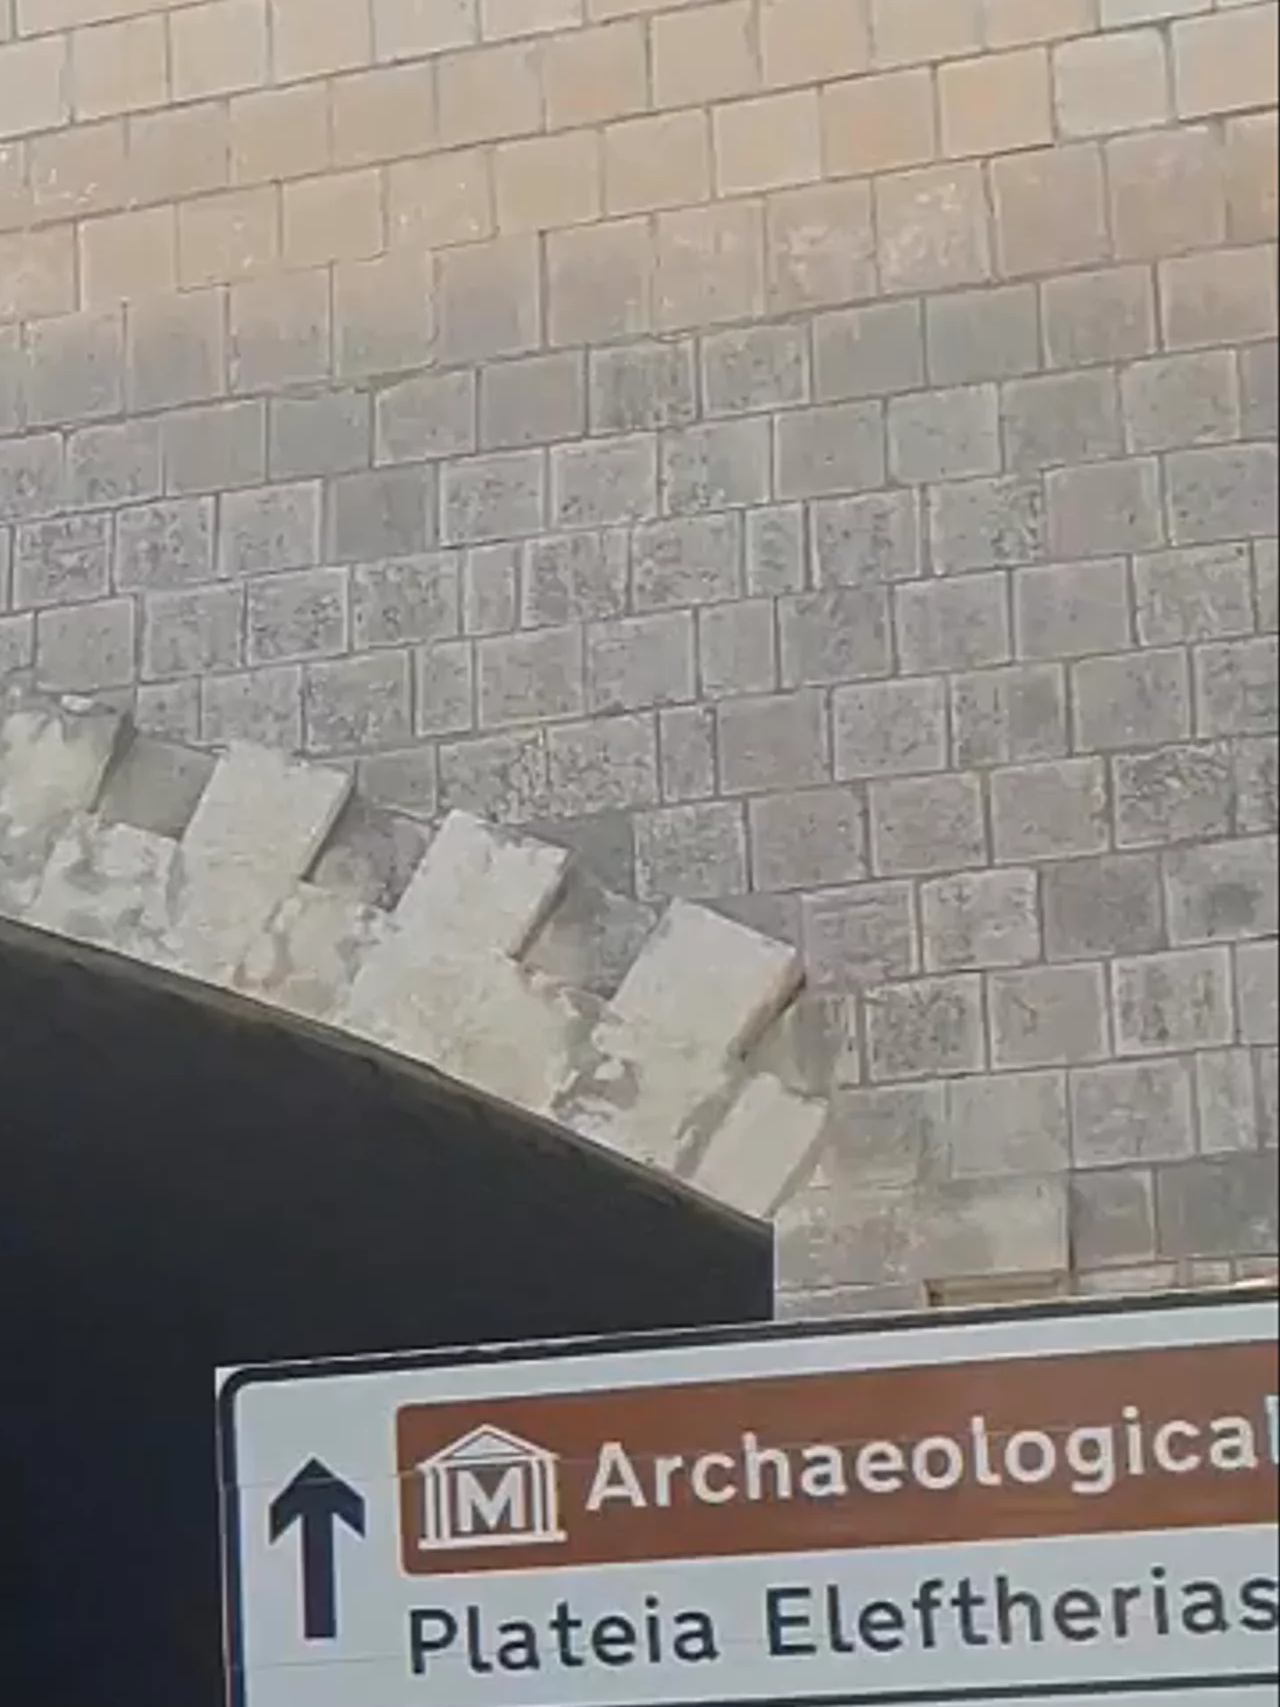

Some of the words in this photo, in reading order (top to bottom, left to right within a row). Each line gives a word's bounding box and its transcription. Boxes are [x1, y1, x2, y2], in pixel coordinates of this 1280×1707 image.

[584, 1394, 1280, 1511] Archaeological
[408, 1595, 721, 1675] Plateia
[766, 1565, 1280, 1658] Eleftherias
